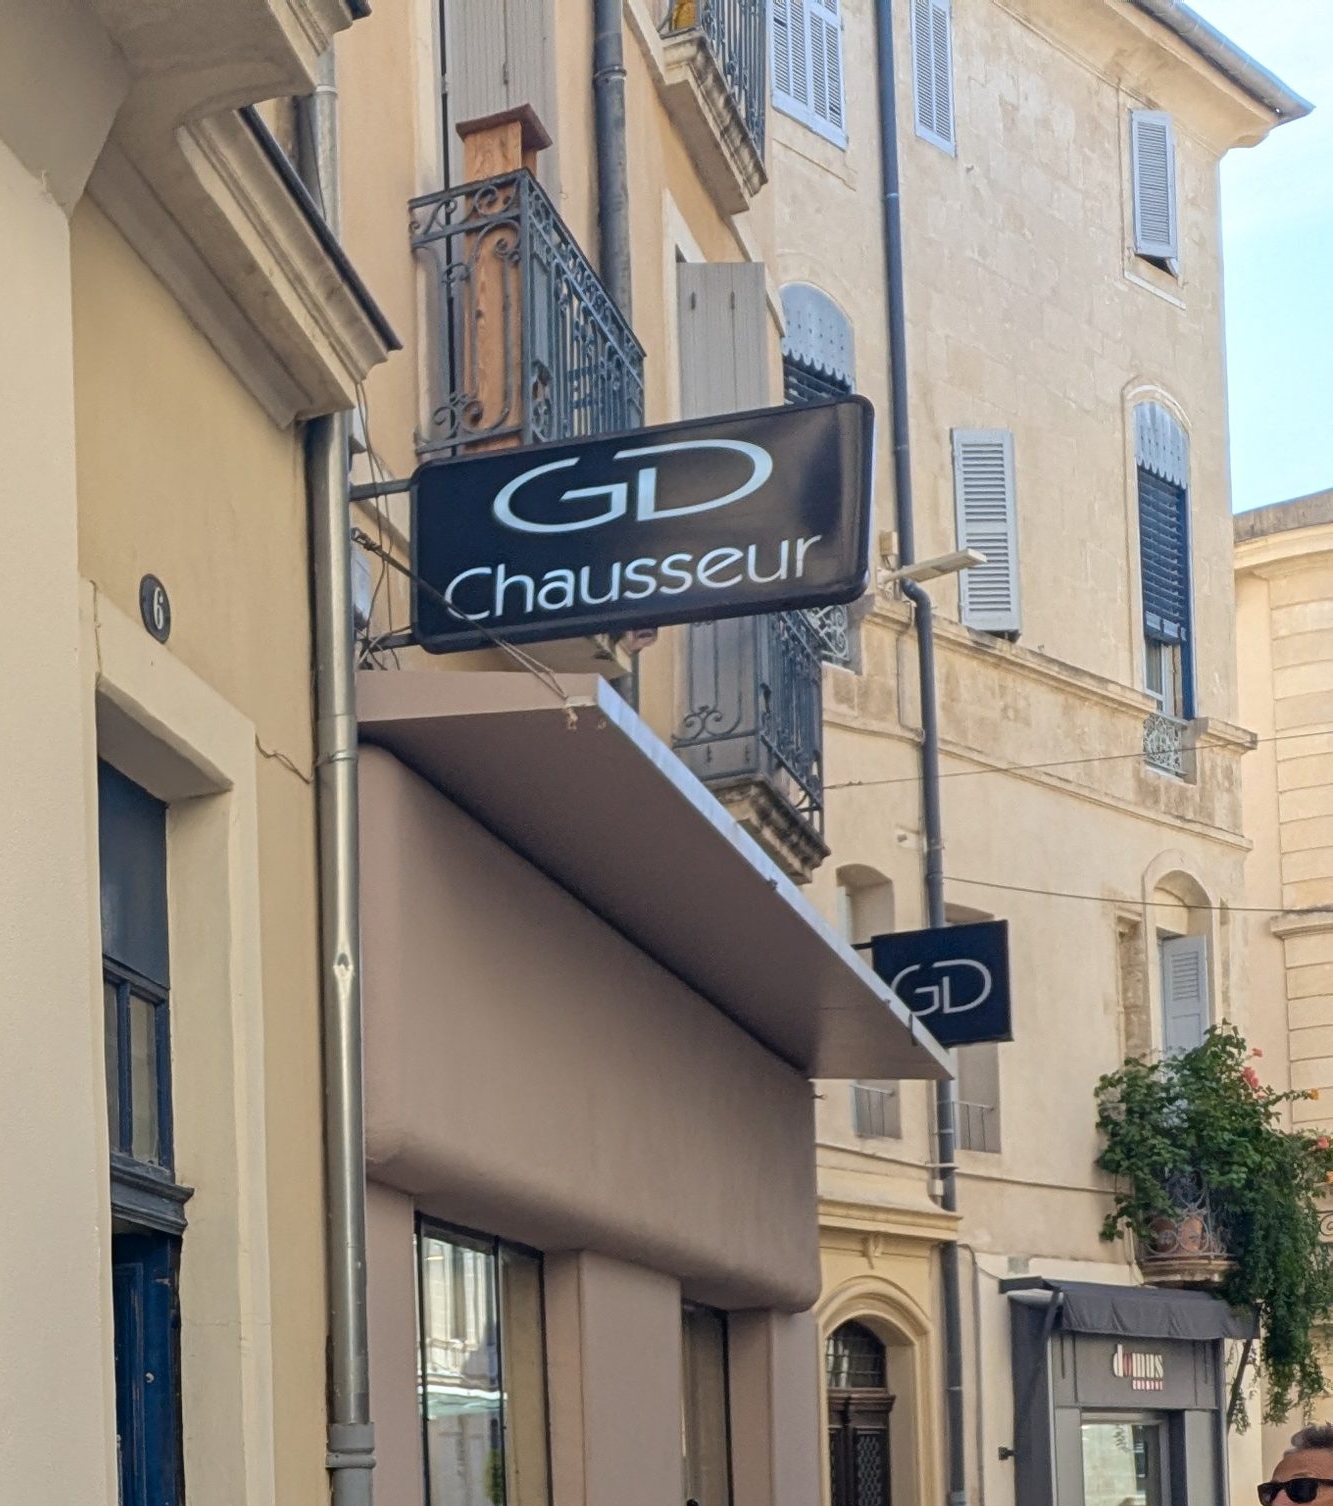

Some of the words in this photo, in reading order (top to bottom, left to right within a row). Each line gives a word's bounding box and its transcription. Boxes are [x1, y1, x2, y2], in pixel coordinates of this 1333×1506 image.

[492, 437, 773, 534] GD
[153, 586, 164, 630] 6
[443, 533, 826, 625] Chausseur
[891, 959, 992, 1017] GD
